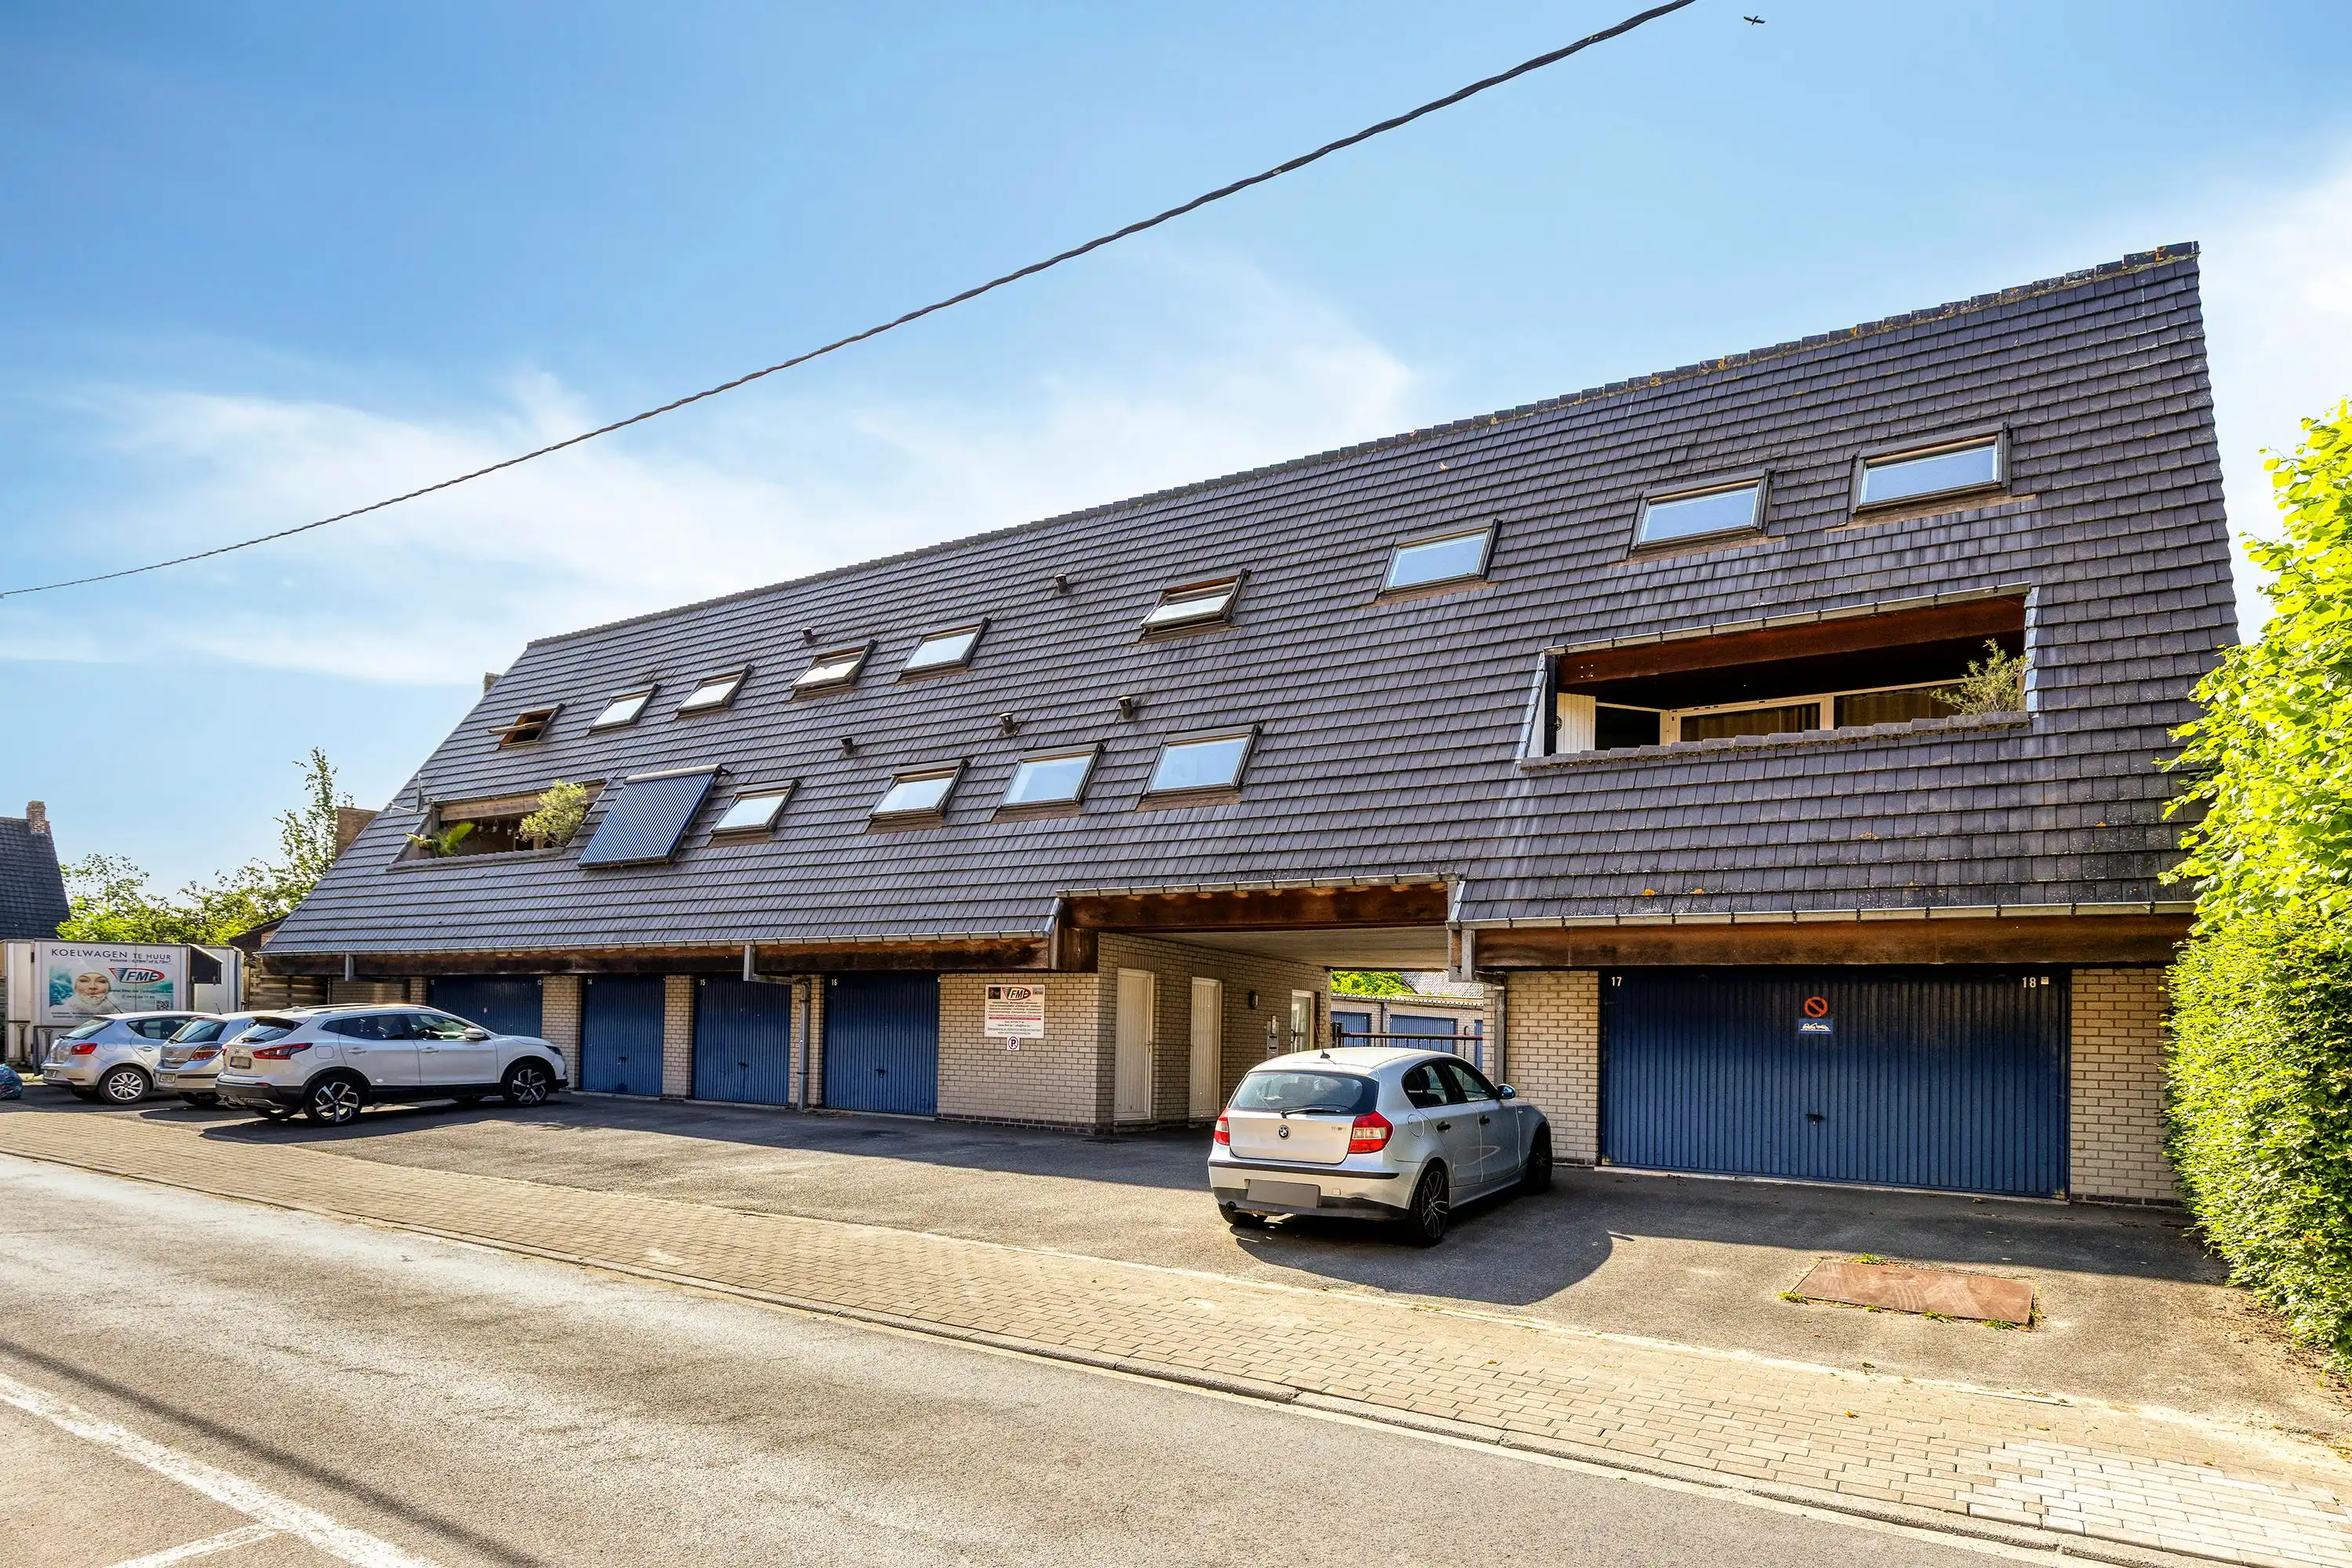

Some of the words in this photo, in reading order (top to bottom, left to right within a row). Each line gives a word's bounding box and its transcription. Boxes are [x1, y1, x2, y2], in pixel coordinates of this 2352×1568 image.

[51, 949, 128, 958] KOELWAGEN
[125, 971, 159, 982] FME
[1611, 976, 1622, 986] 17
[2022, 977, 2037, 988] 18
[1010, 989, 1029, 999] FME
